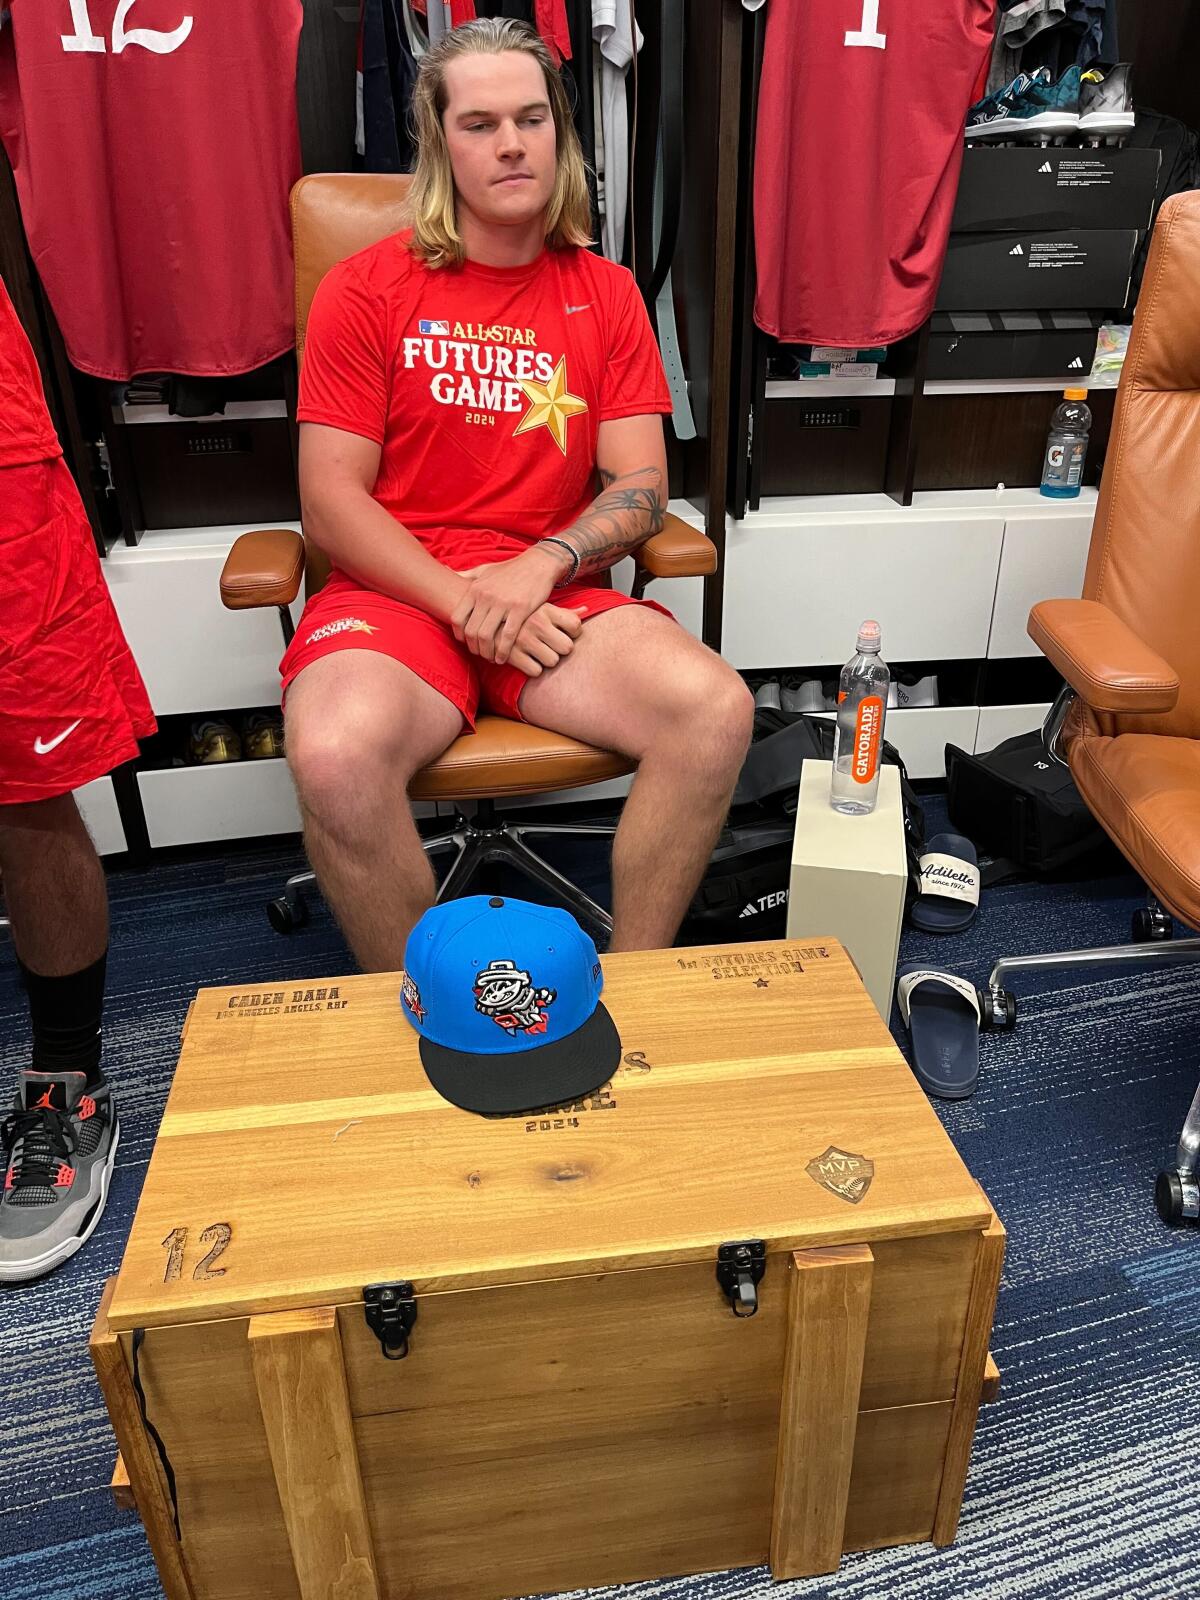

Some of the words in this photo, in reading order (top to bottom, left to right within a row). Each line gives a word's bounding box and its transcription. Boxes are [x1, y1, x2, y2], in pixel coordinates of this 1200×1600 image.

[403, 337, 554, 381] FUTURES
[430, 373, 523, 412] GAME
[465, 412, 495, 426] 2024
[871, 705, 880, 735] WATER
[856, 705, 874, 776] GATORADE
[920, 864, 975, 886] Adilette
[931, 879, 950, 887] since
[757, 889, 790, 912] TER
[701, 951, 777, 969] FUTURES
[782, 947, 830, 962] GAME
[711, 961, 805, 980] SELECTION
[228, 992, 285, 1009] CADEN
[292, 987, 340, 1003] DANA
[237, 1006, 280, 1018] ANGELES
[326, 1001, 348, 1010] RHP
[525, 1117, 580, 1133] 2024
[818, 1160, 860, 1175] MVP
[161, 1222, 233, 1284] 12
